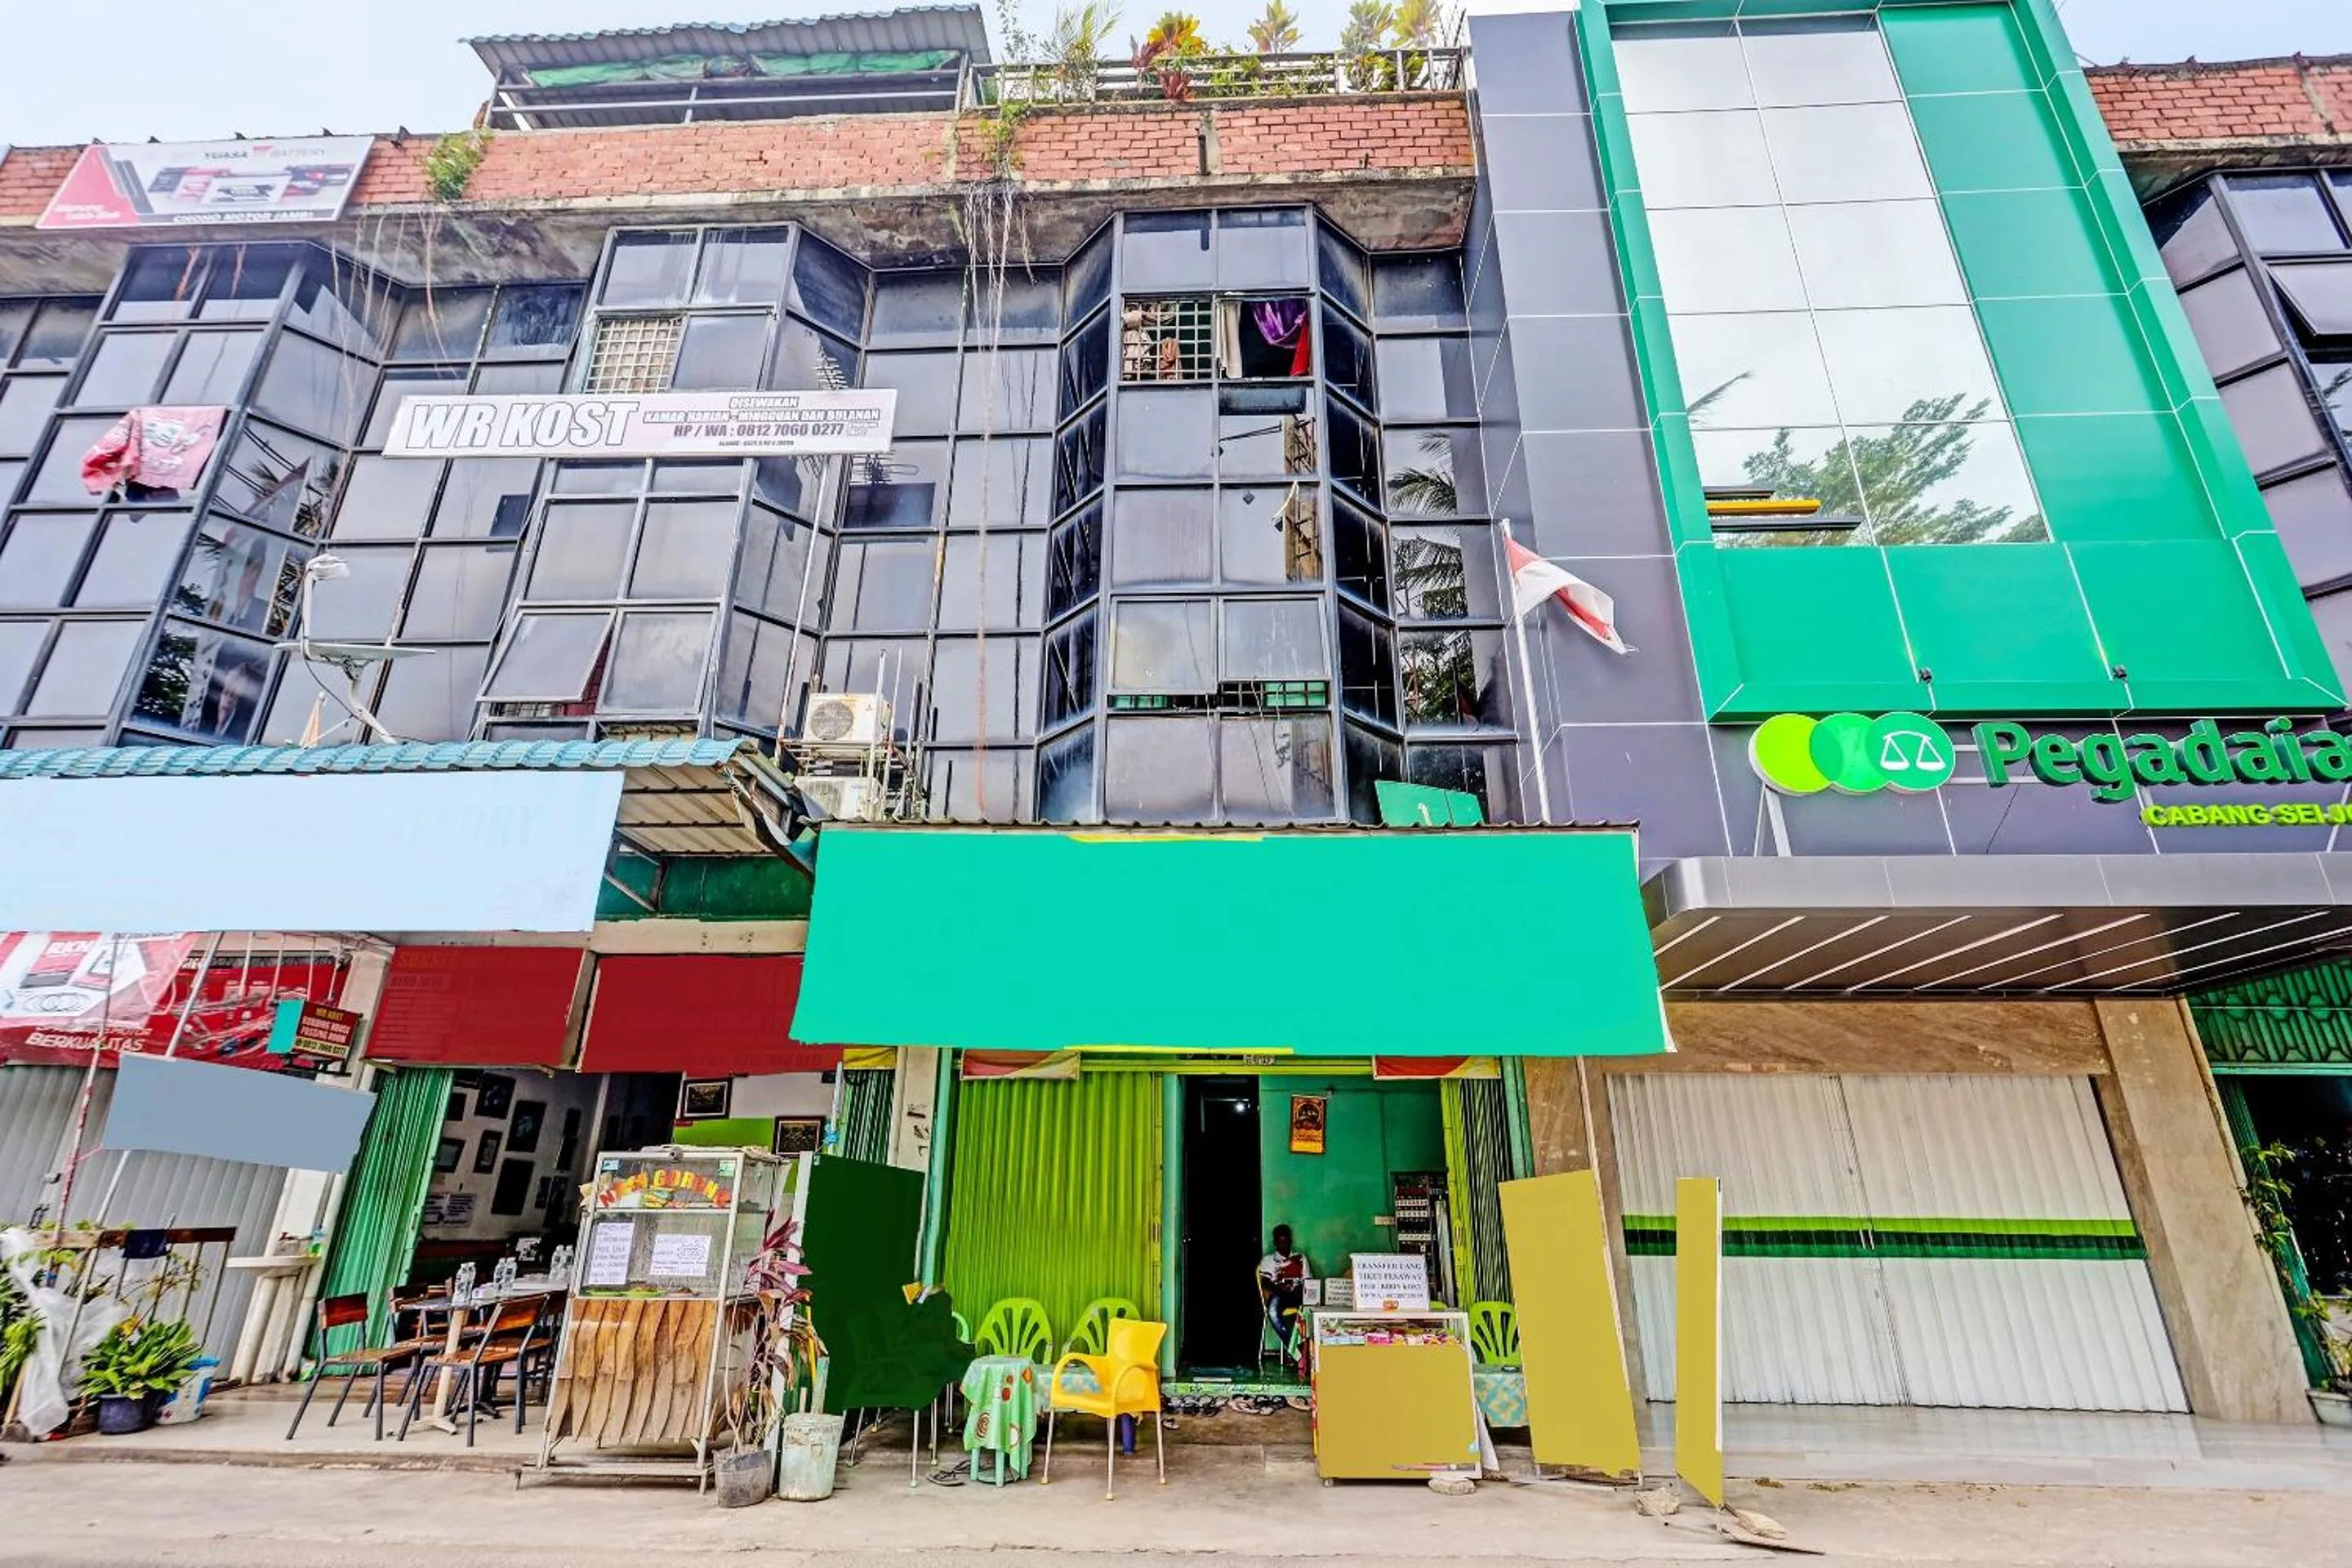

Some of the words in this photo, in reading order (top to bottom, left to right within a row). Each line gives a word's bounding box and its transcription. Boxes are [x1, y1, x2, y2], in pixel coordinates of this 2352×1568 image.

[729, 396, 800, 408] DISEWAKAN
[643, 411, 686, 424] KAMAR
[686, 410, 731, 423] HARIAN
[800, 409, 826, 421] DAN
[825, 408, 880, 421] BULANAN
[406, 403, 497, 448] WR
[499, 401, 640, 447] KOST
[674, 425, 693, 437] HP
[705, 425, 728, 437] WA
[737, 424, 770, 436] 0812
[773, 423, 808, 436] 7060
[812, 422, 844, 435] 0277
[2140, 804, 2273, 827] CABANG
[2274, 803, 2326, 826] SEI
